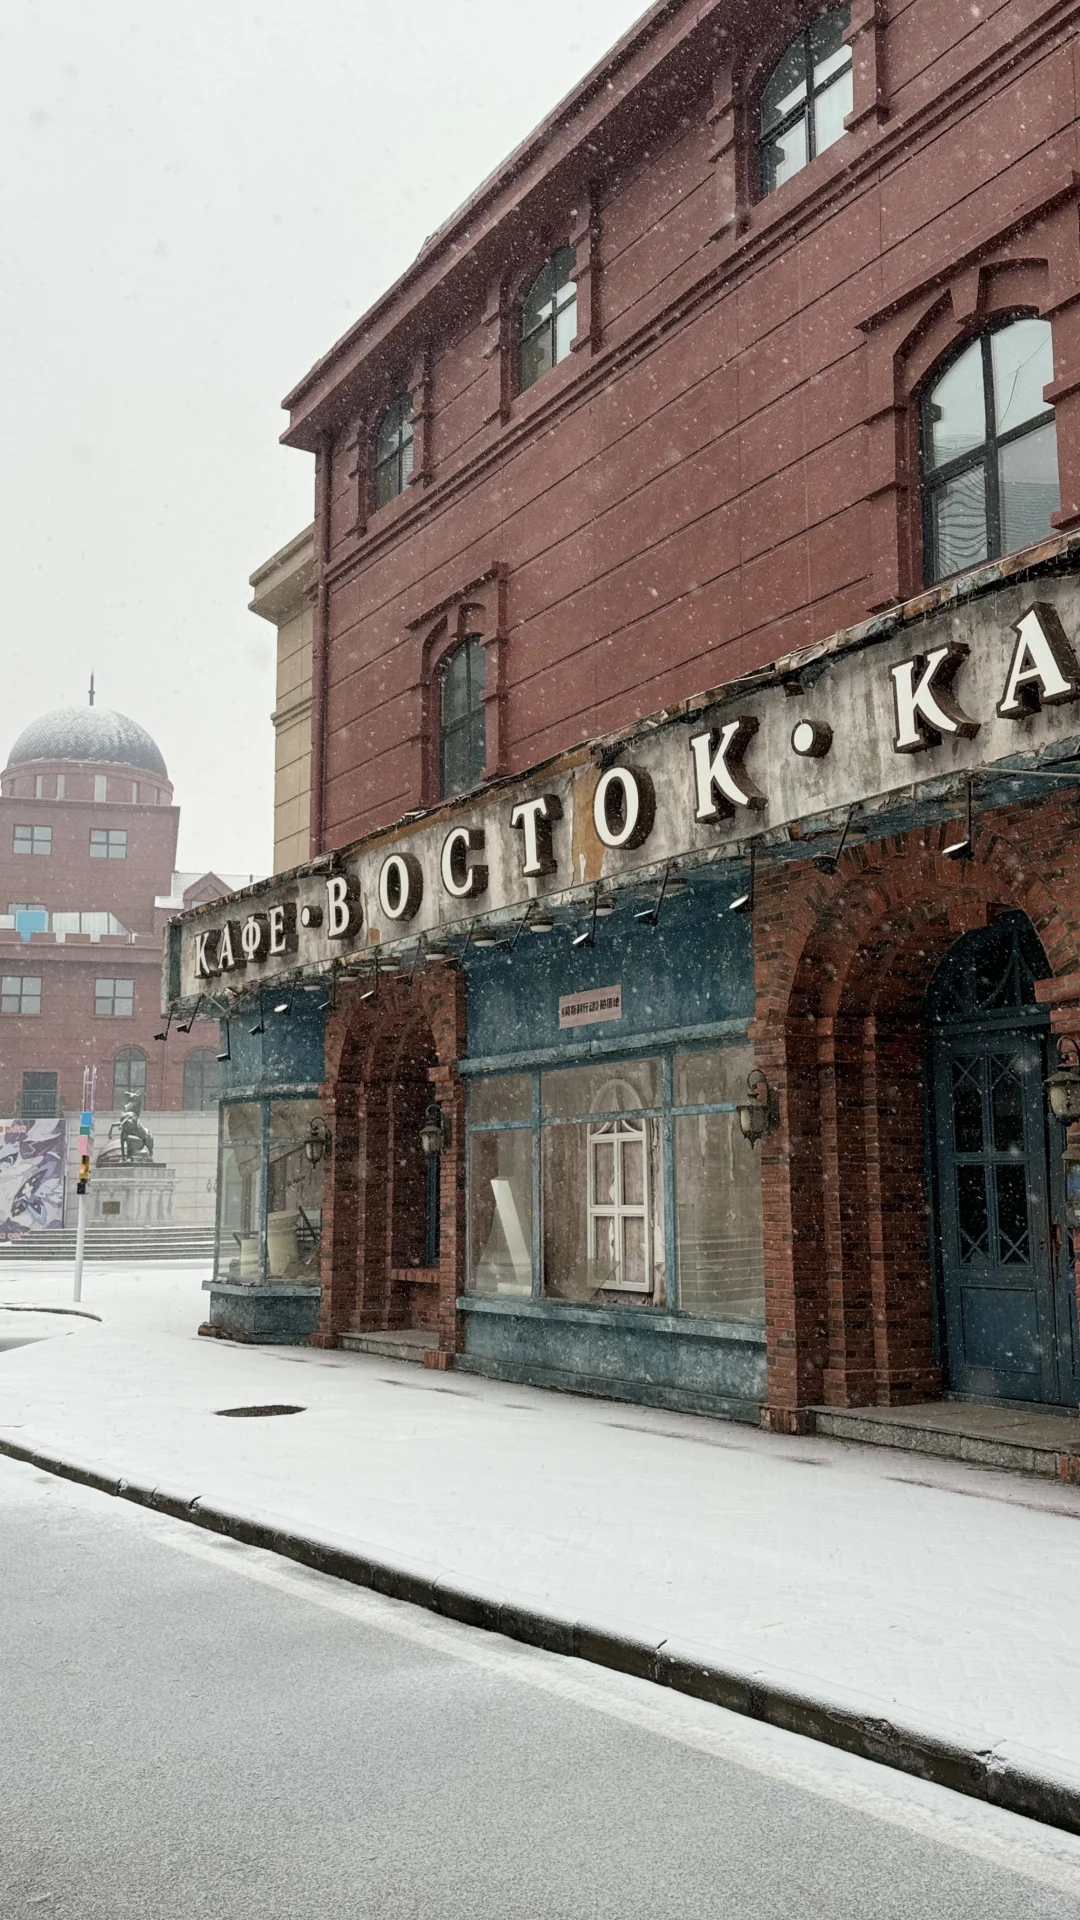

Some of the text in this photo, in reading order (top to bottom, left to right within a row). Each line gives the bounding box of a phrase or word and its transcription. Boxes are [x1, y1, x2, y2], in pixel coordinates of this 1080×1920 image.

[193, 606, 1074, 978] КАФЕ ВОСТОК КА
